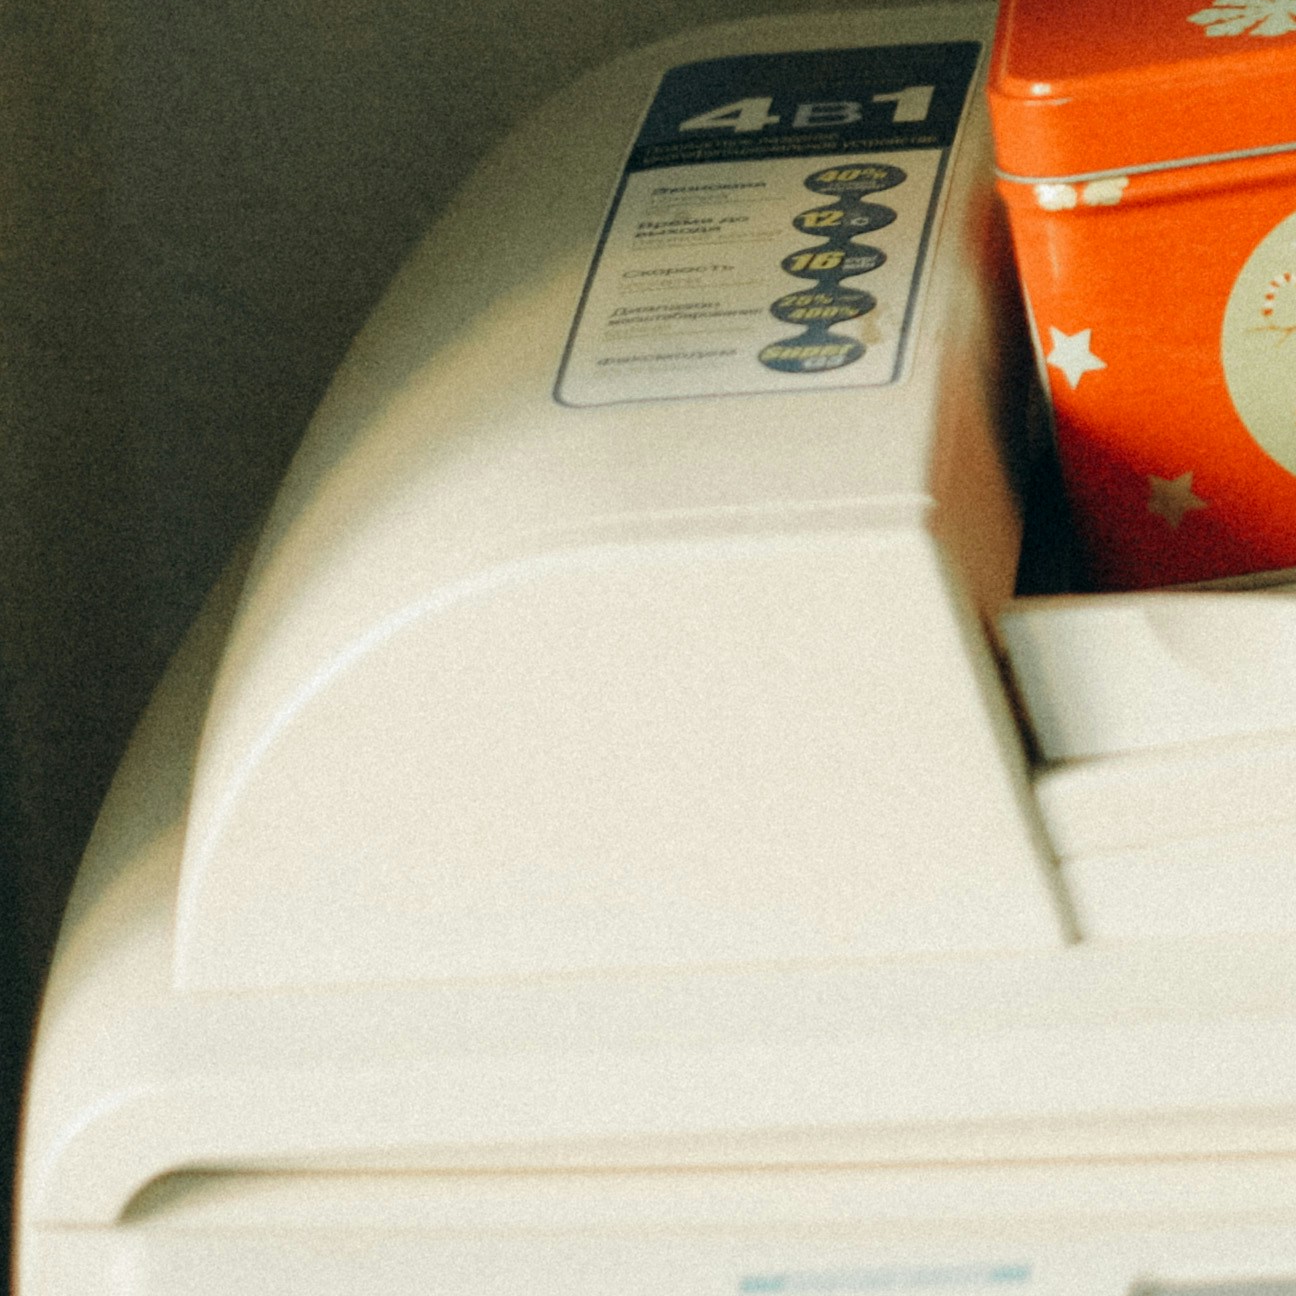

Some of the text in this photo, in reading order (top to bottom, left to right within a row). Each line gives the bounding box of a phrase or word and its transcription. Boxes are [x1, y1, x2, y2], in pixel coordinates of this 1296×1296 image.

[679, 97, 780, 133] 4
[872, 86, 936, 122] 1
[816, 168, 888, 182] 40%
[800, 210, 844, 228] 12
[790, 250, 846, 272] 16
[622, 264, 735, 278] Скорость
